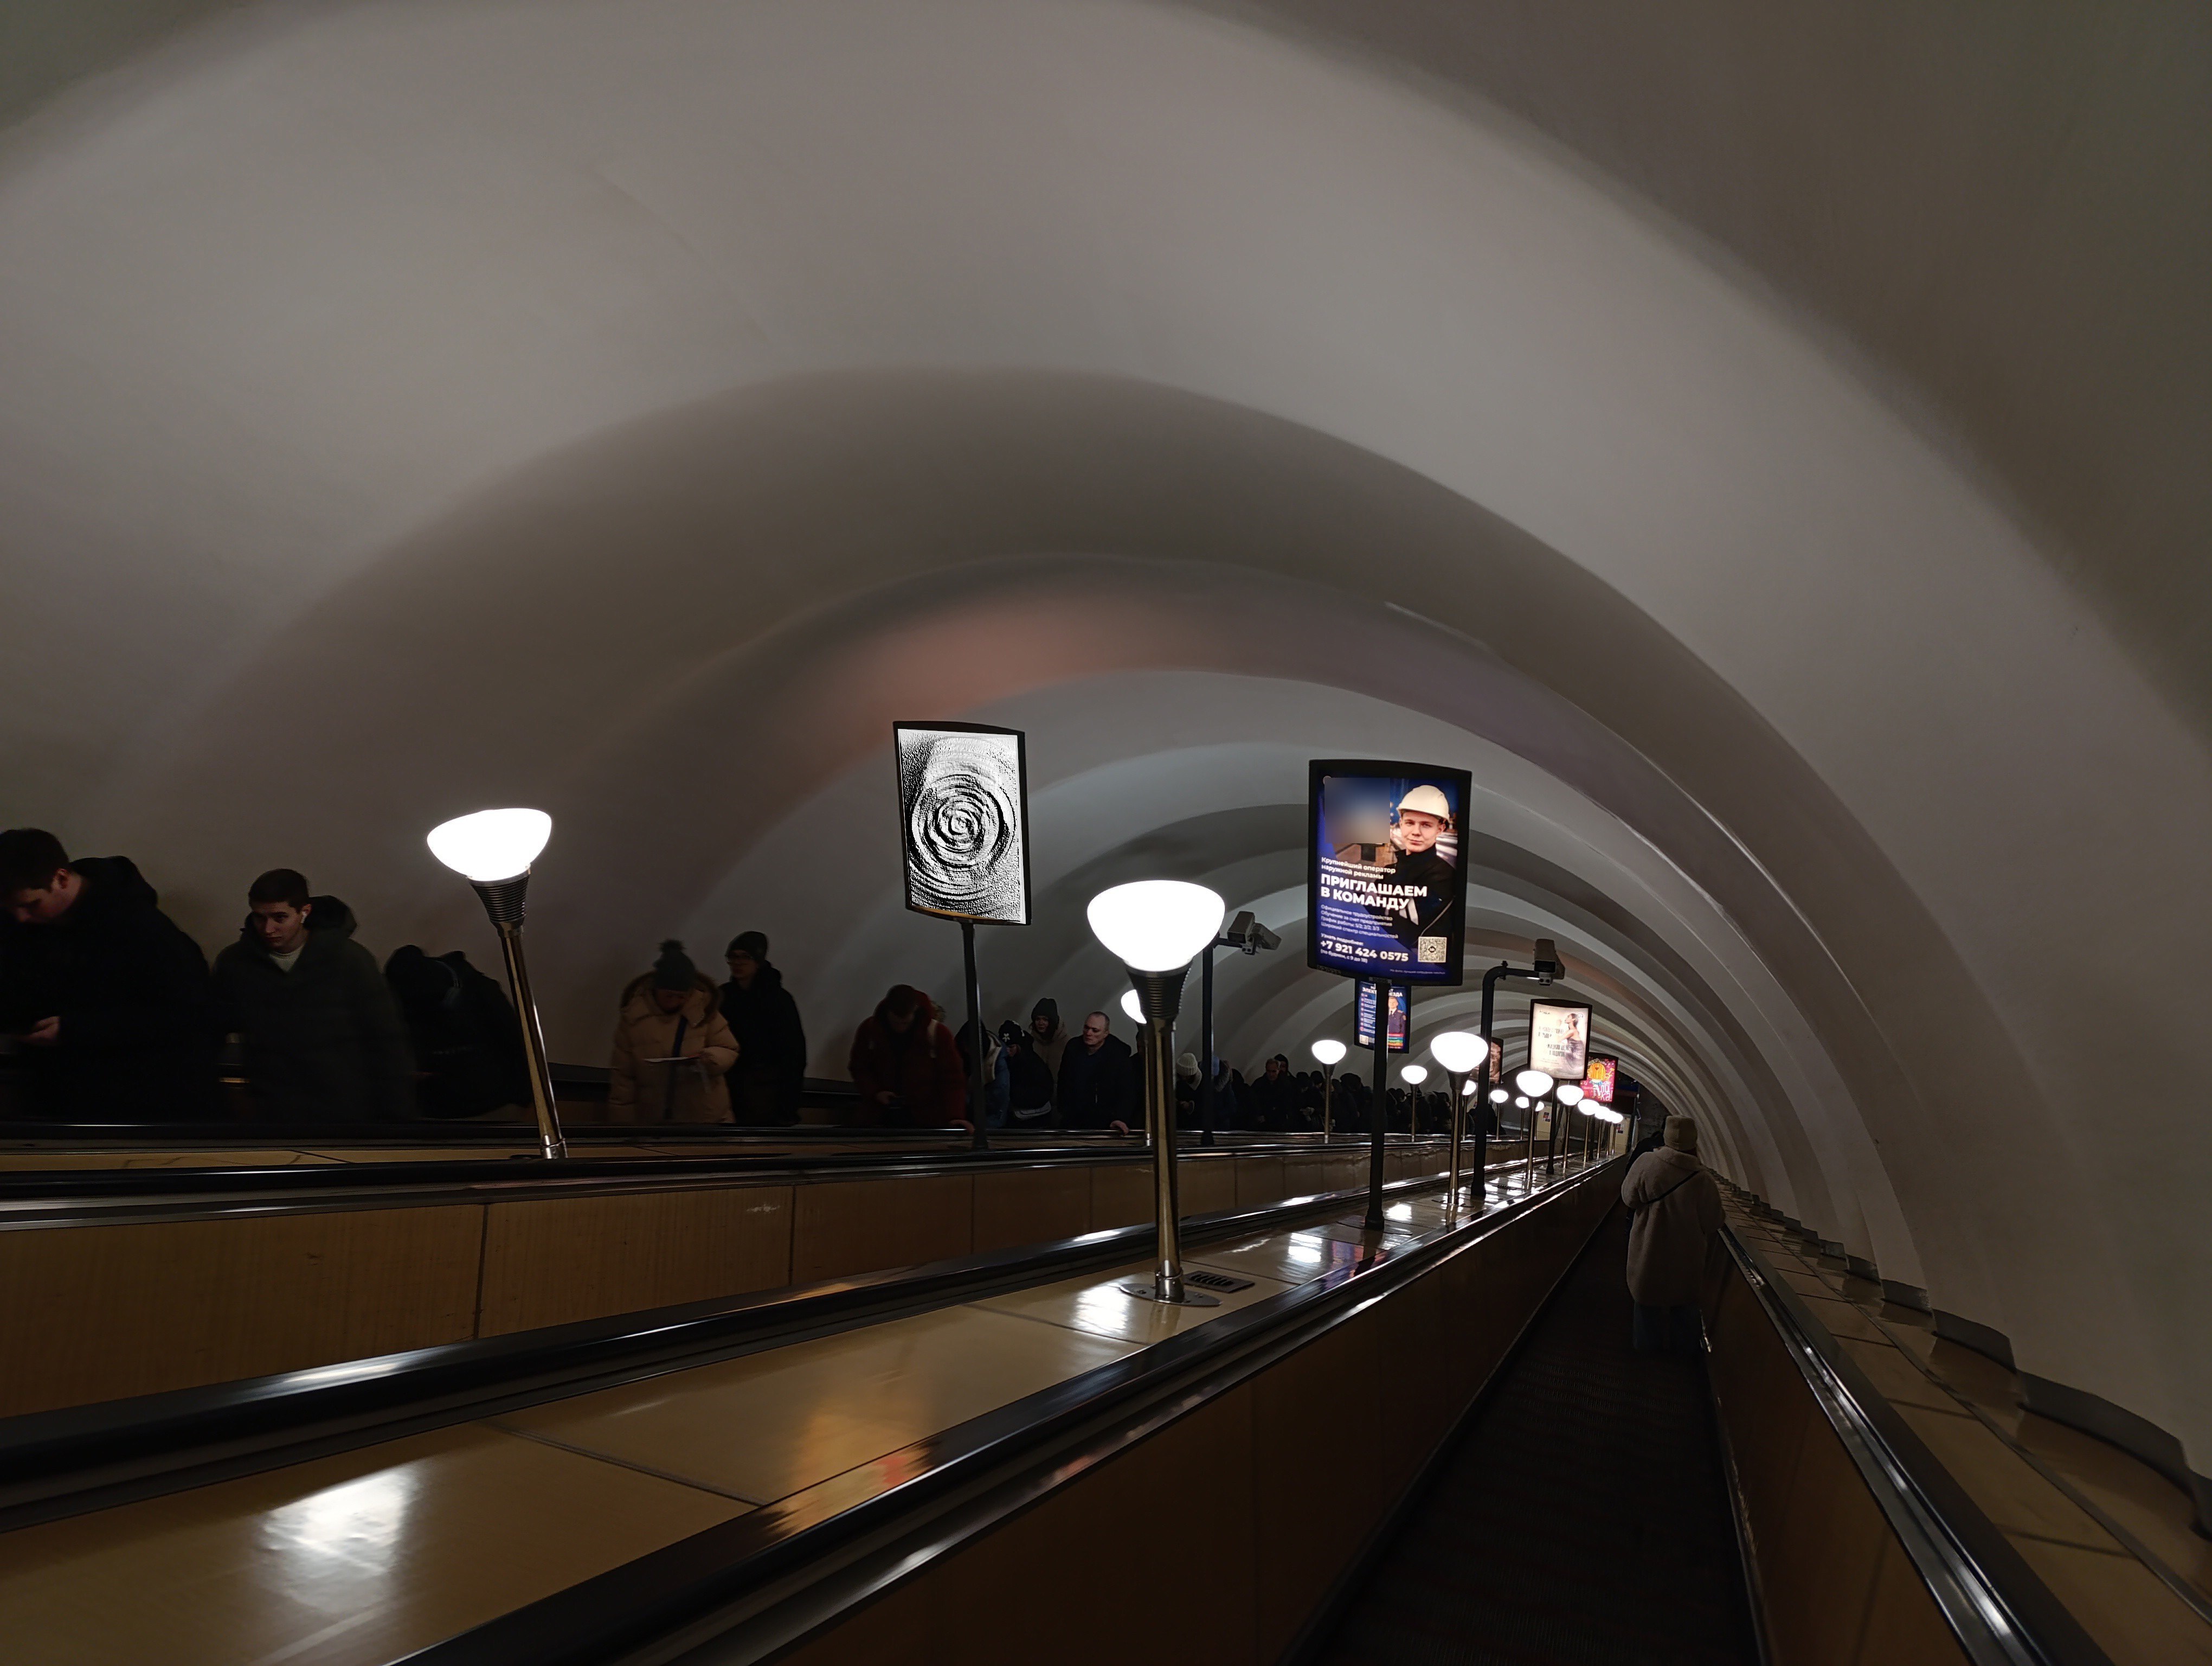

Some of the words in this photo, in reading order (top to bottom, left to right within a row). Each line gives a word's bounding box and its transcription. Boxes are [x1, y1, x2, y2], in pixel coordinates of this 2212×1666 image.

[1321, 857, 1362, 869] Крупнейший
[1363, 865, 1396, 874] оператор
[1321, 864, 1352, 875] наружной
[1354, 870, 1384, 879] рекламы
[1321, 873, 1427, 897] ПРИГЛАШАЕМ
[1321, 886, 1330, 898] В
[1333, 888, 1410, 911] КОМАНДУ
[1320, 940, 1333, 949] +7
[1335, 943, 1352, 954] 921
[1355, 947, 1377, 958] 424
[1380, 951, 1409, 962] 0575
